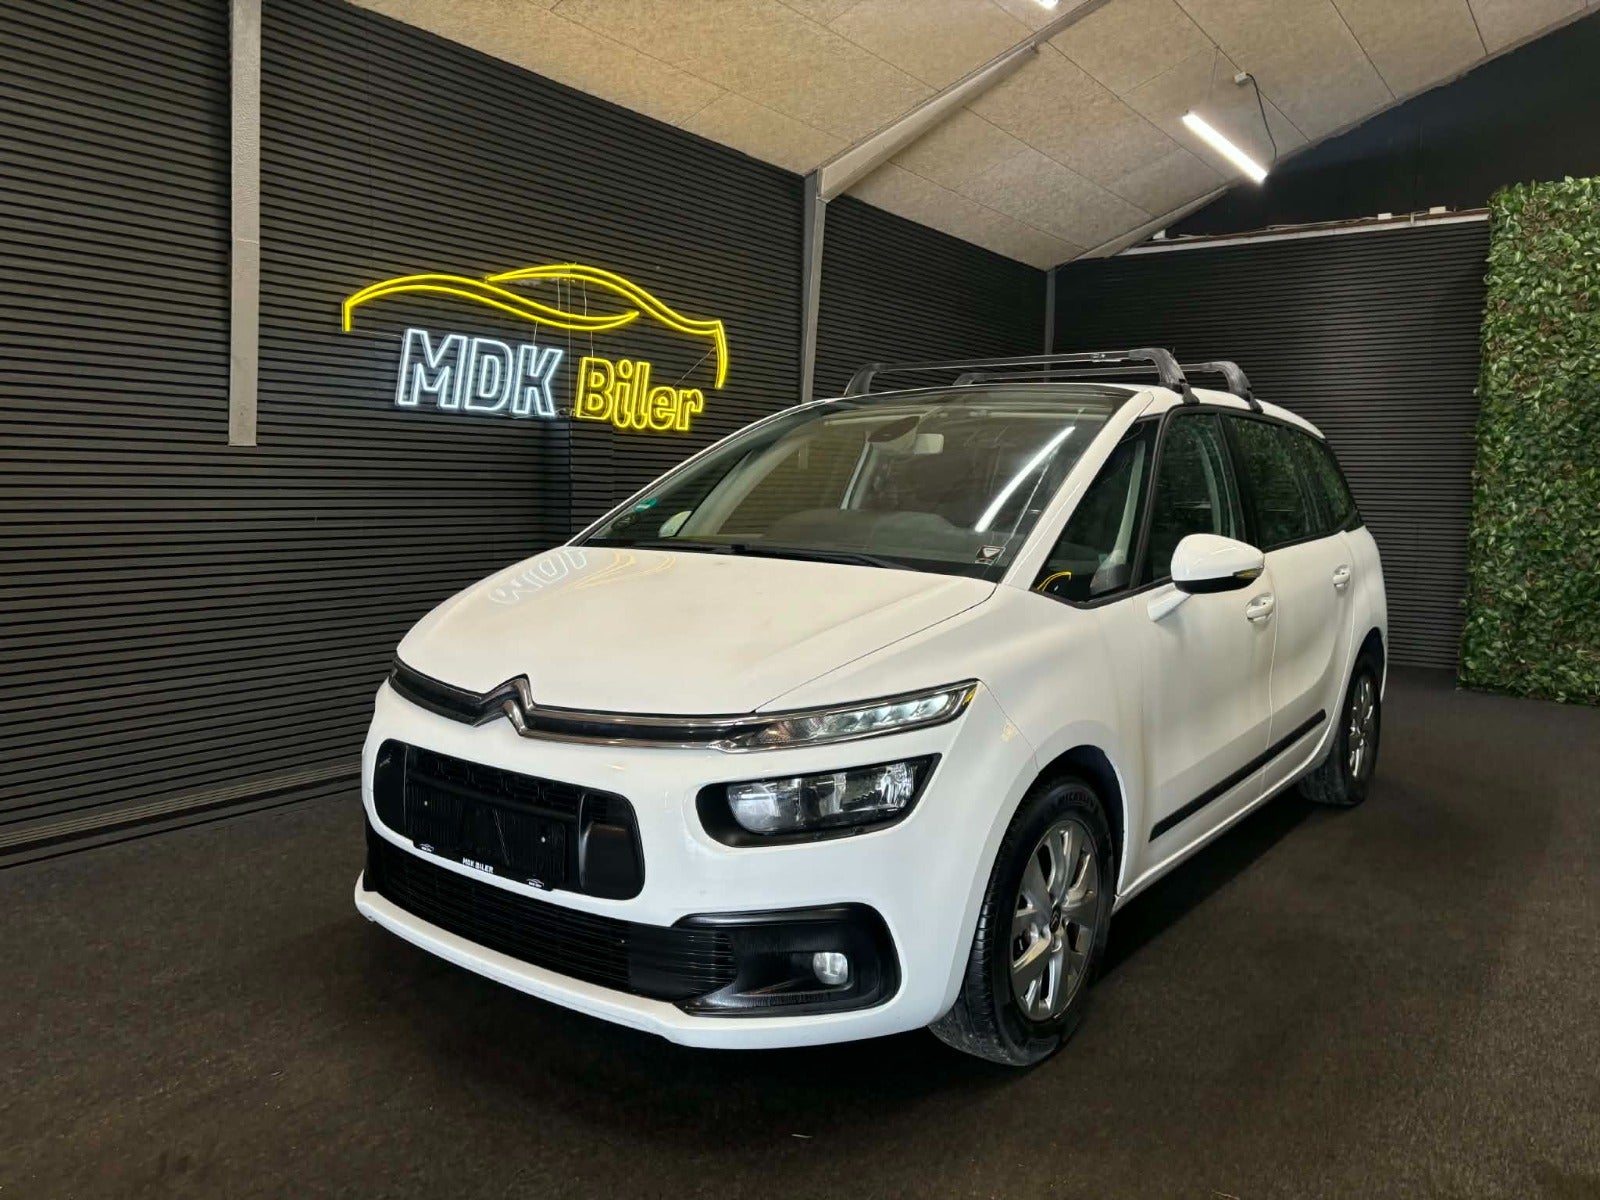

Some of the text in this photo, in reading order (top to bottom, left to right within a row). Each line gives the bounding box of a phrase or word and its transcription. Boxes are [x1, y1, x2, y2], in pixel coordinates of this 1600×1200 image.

[395, 327, 705, 433] MDK Biler
[475, 861, 494, 874] BILER
